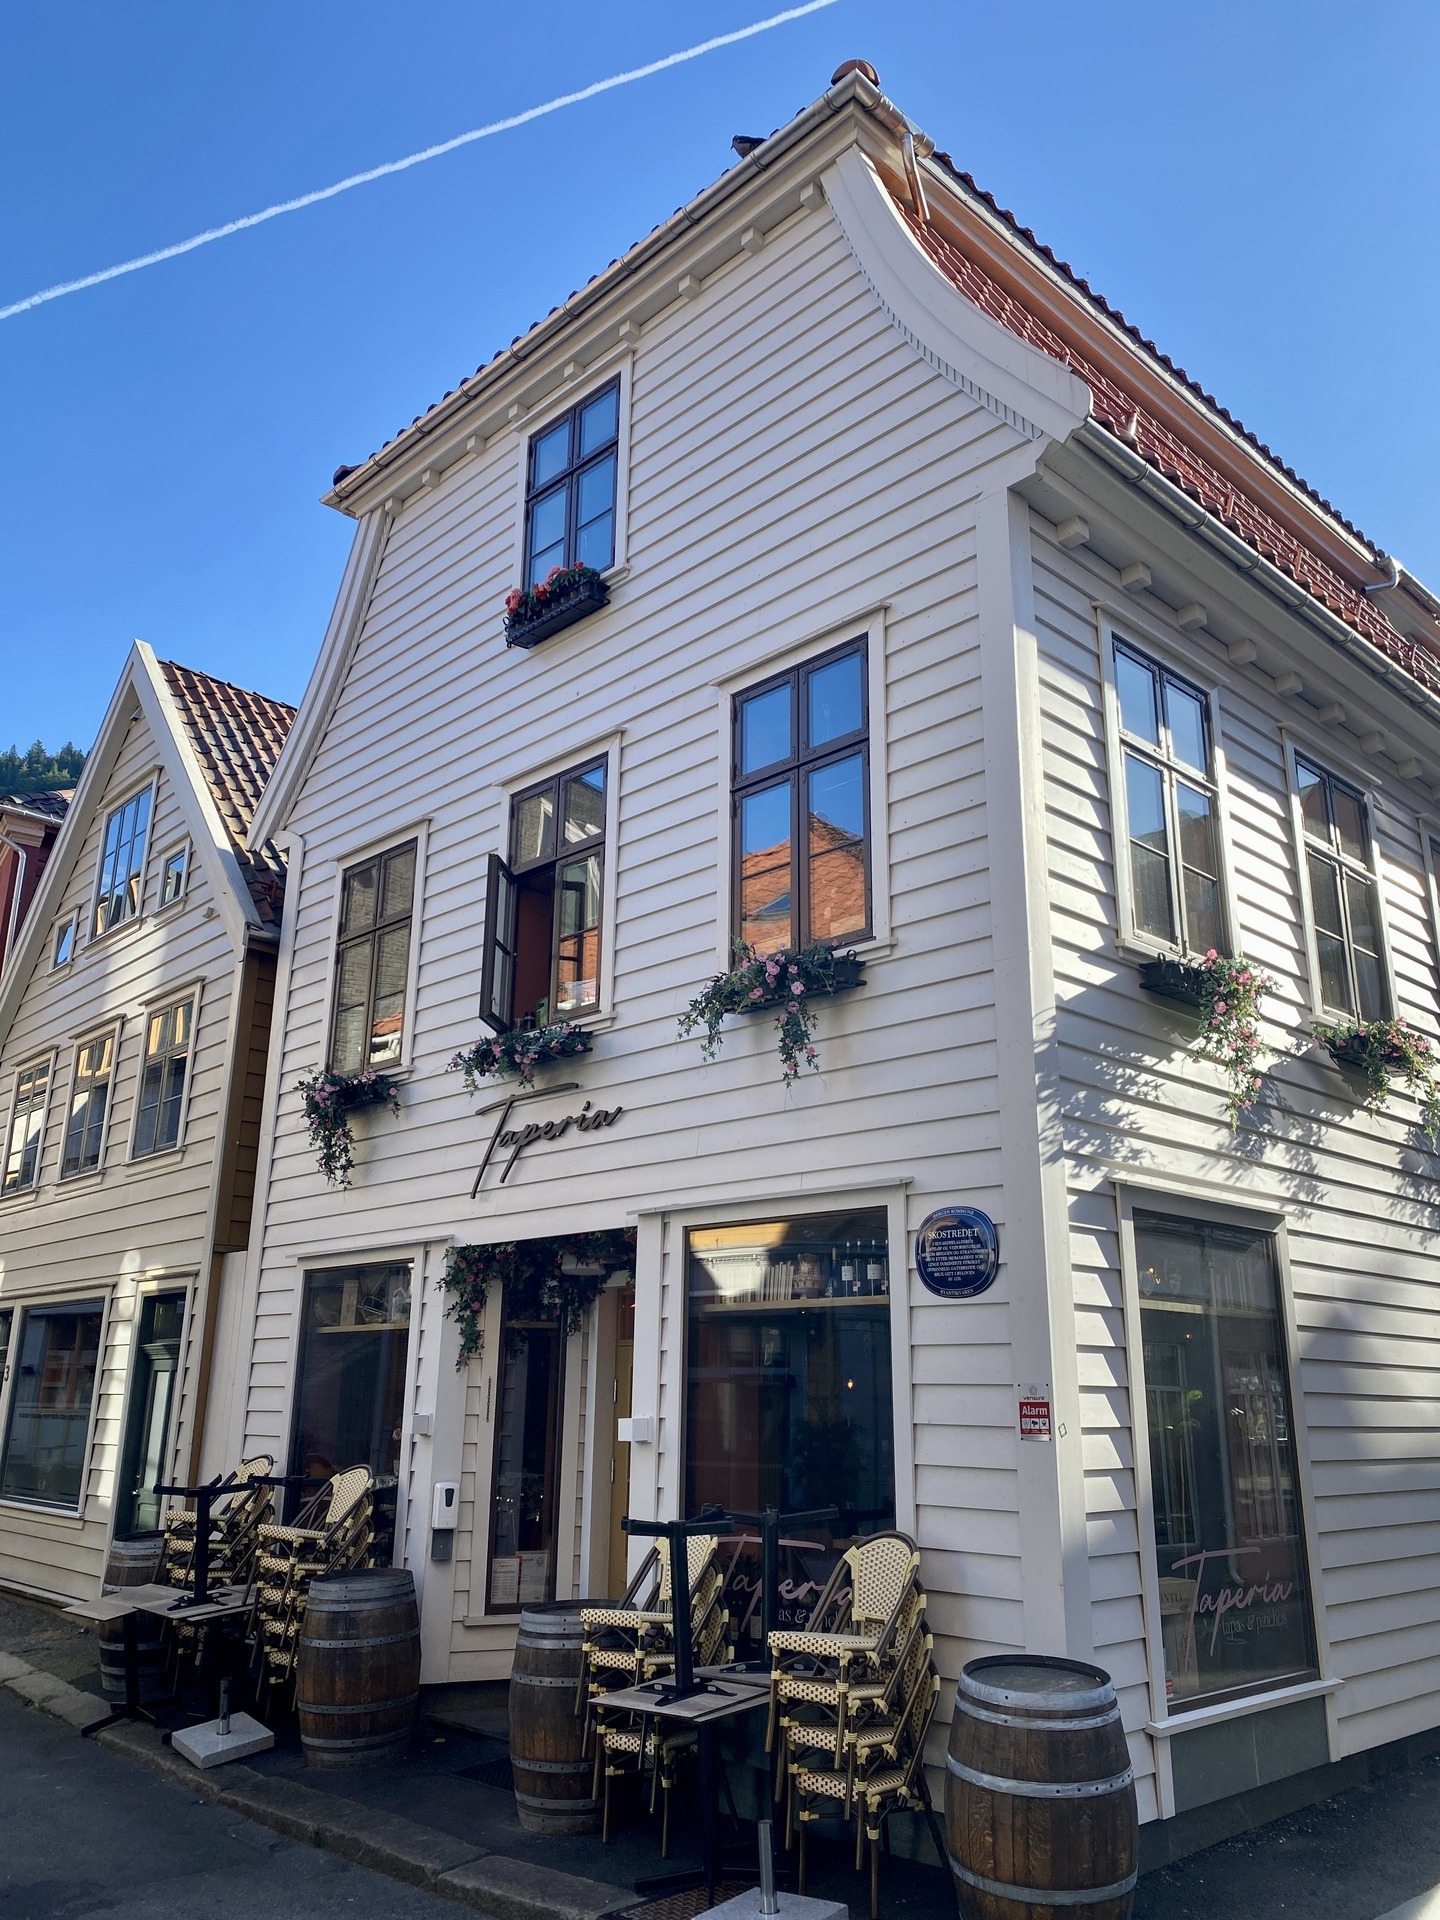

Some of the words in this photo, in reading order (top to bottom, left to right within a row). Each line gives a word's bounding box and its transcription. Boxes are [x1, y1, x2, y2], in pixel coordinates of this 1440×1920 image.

[927, 1228, 979, 1240] SKOSTREDET
[4, 1365, 10, 1382] 3
[1022, 1405, 1048, 1416] Alarm
[1222, 1618, 1245, 1640] tapas
[1247, 1614, 1255, 1630] &
